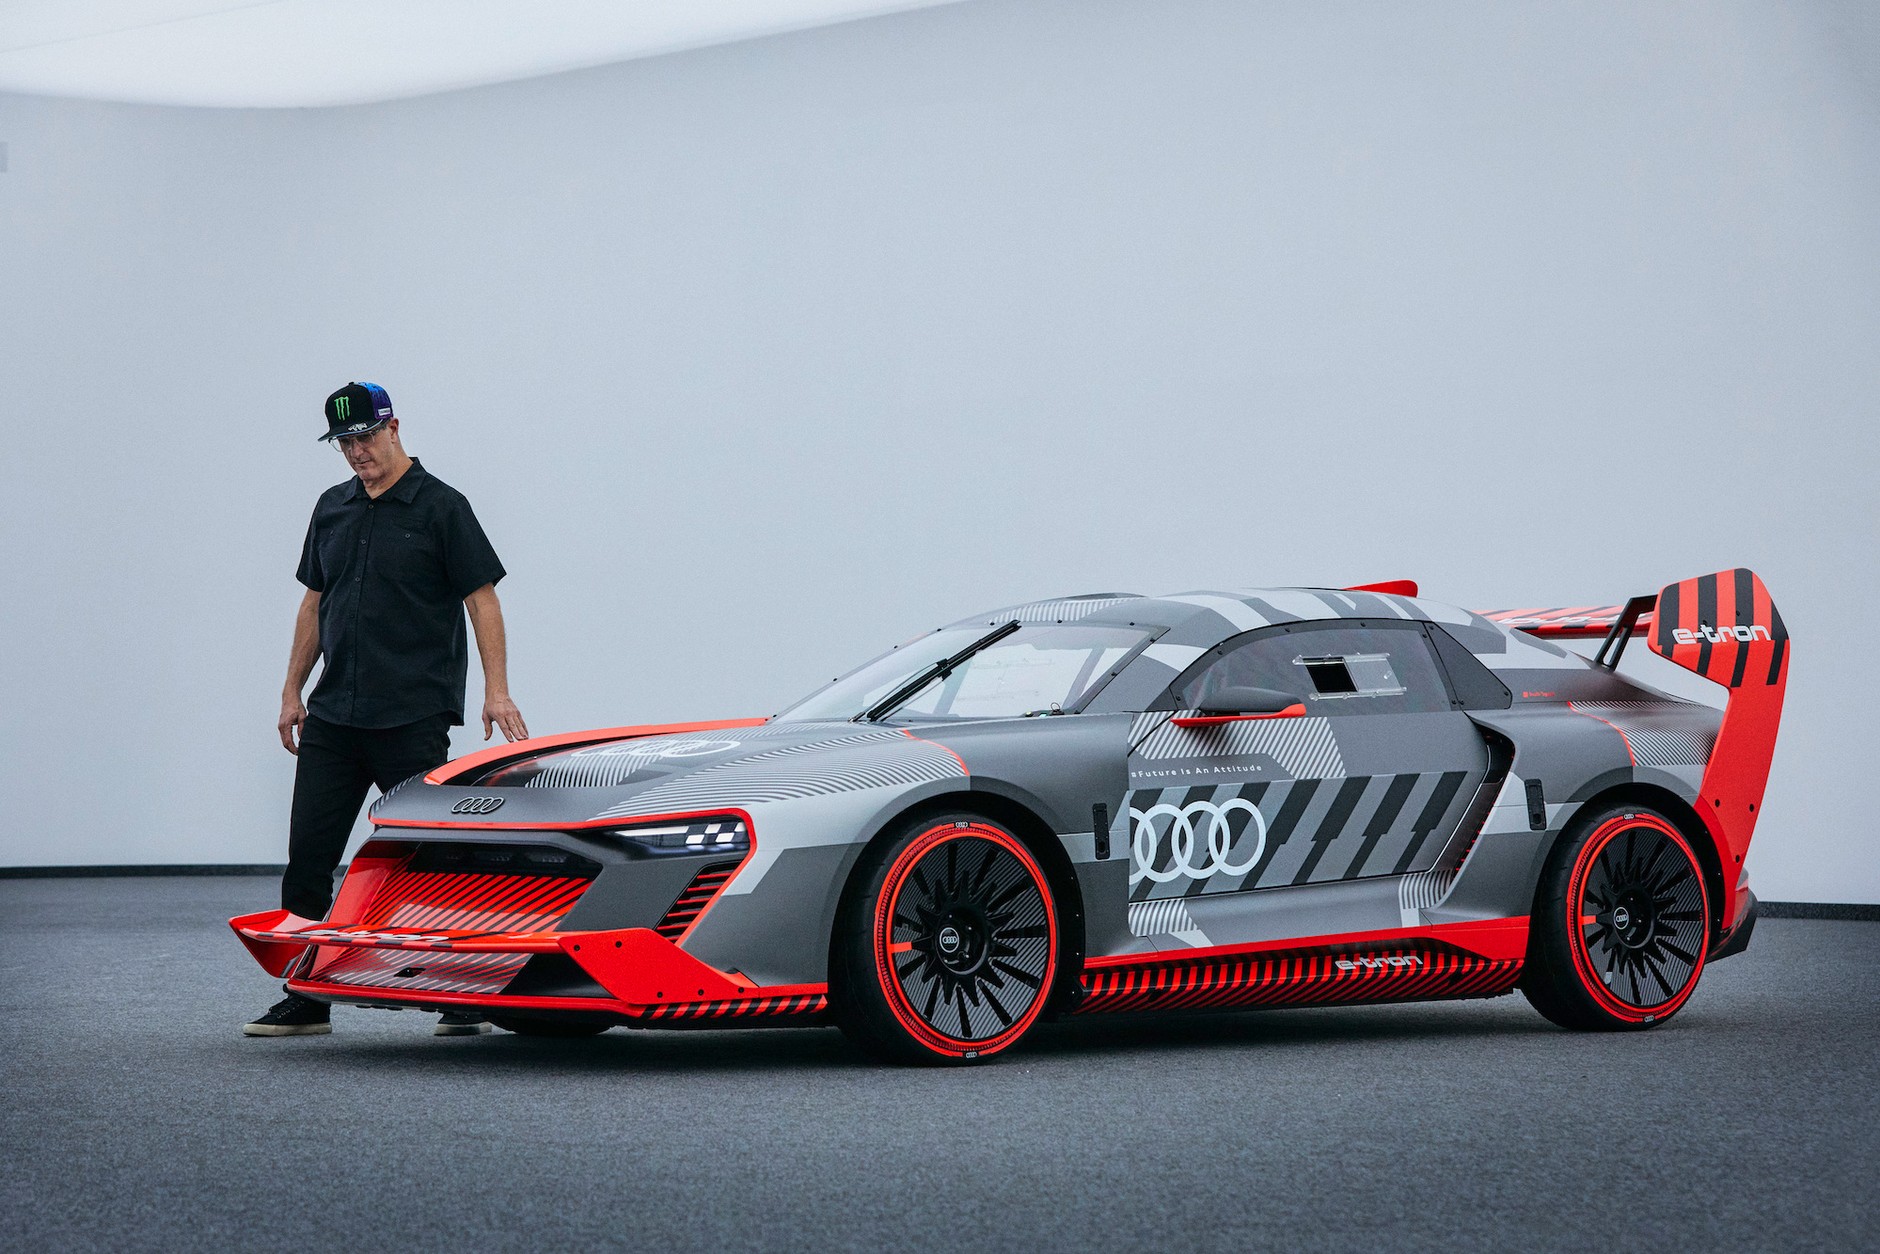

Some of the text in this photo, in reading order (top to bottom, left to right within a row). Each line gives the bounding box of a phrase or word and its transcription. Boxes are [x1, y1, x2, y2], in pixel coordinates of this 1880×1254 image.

[1671, 624, 1772, 645] e-tron
[1213, 764, 1262, 773] Attitude
[1334, 955, 1424, 971] e-tron
